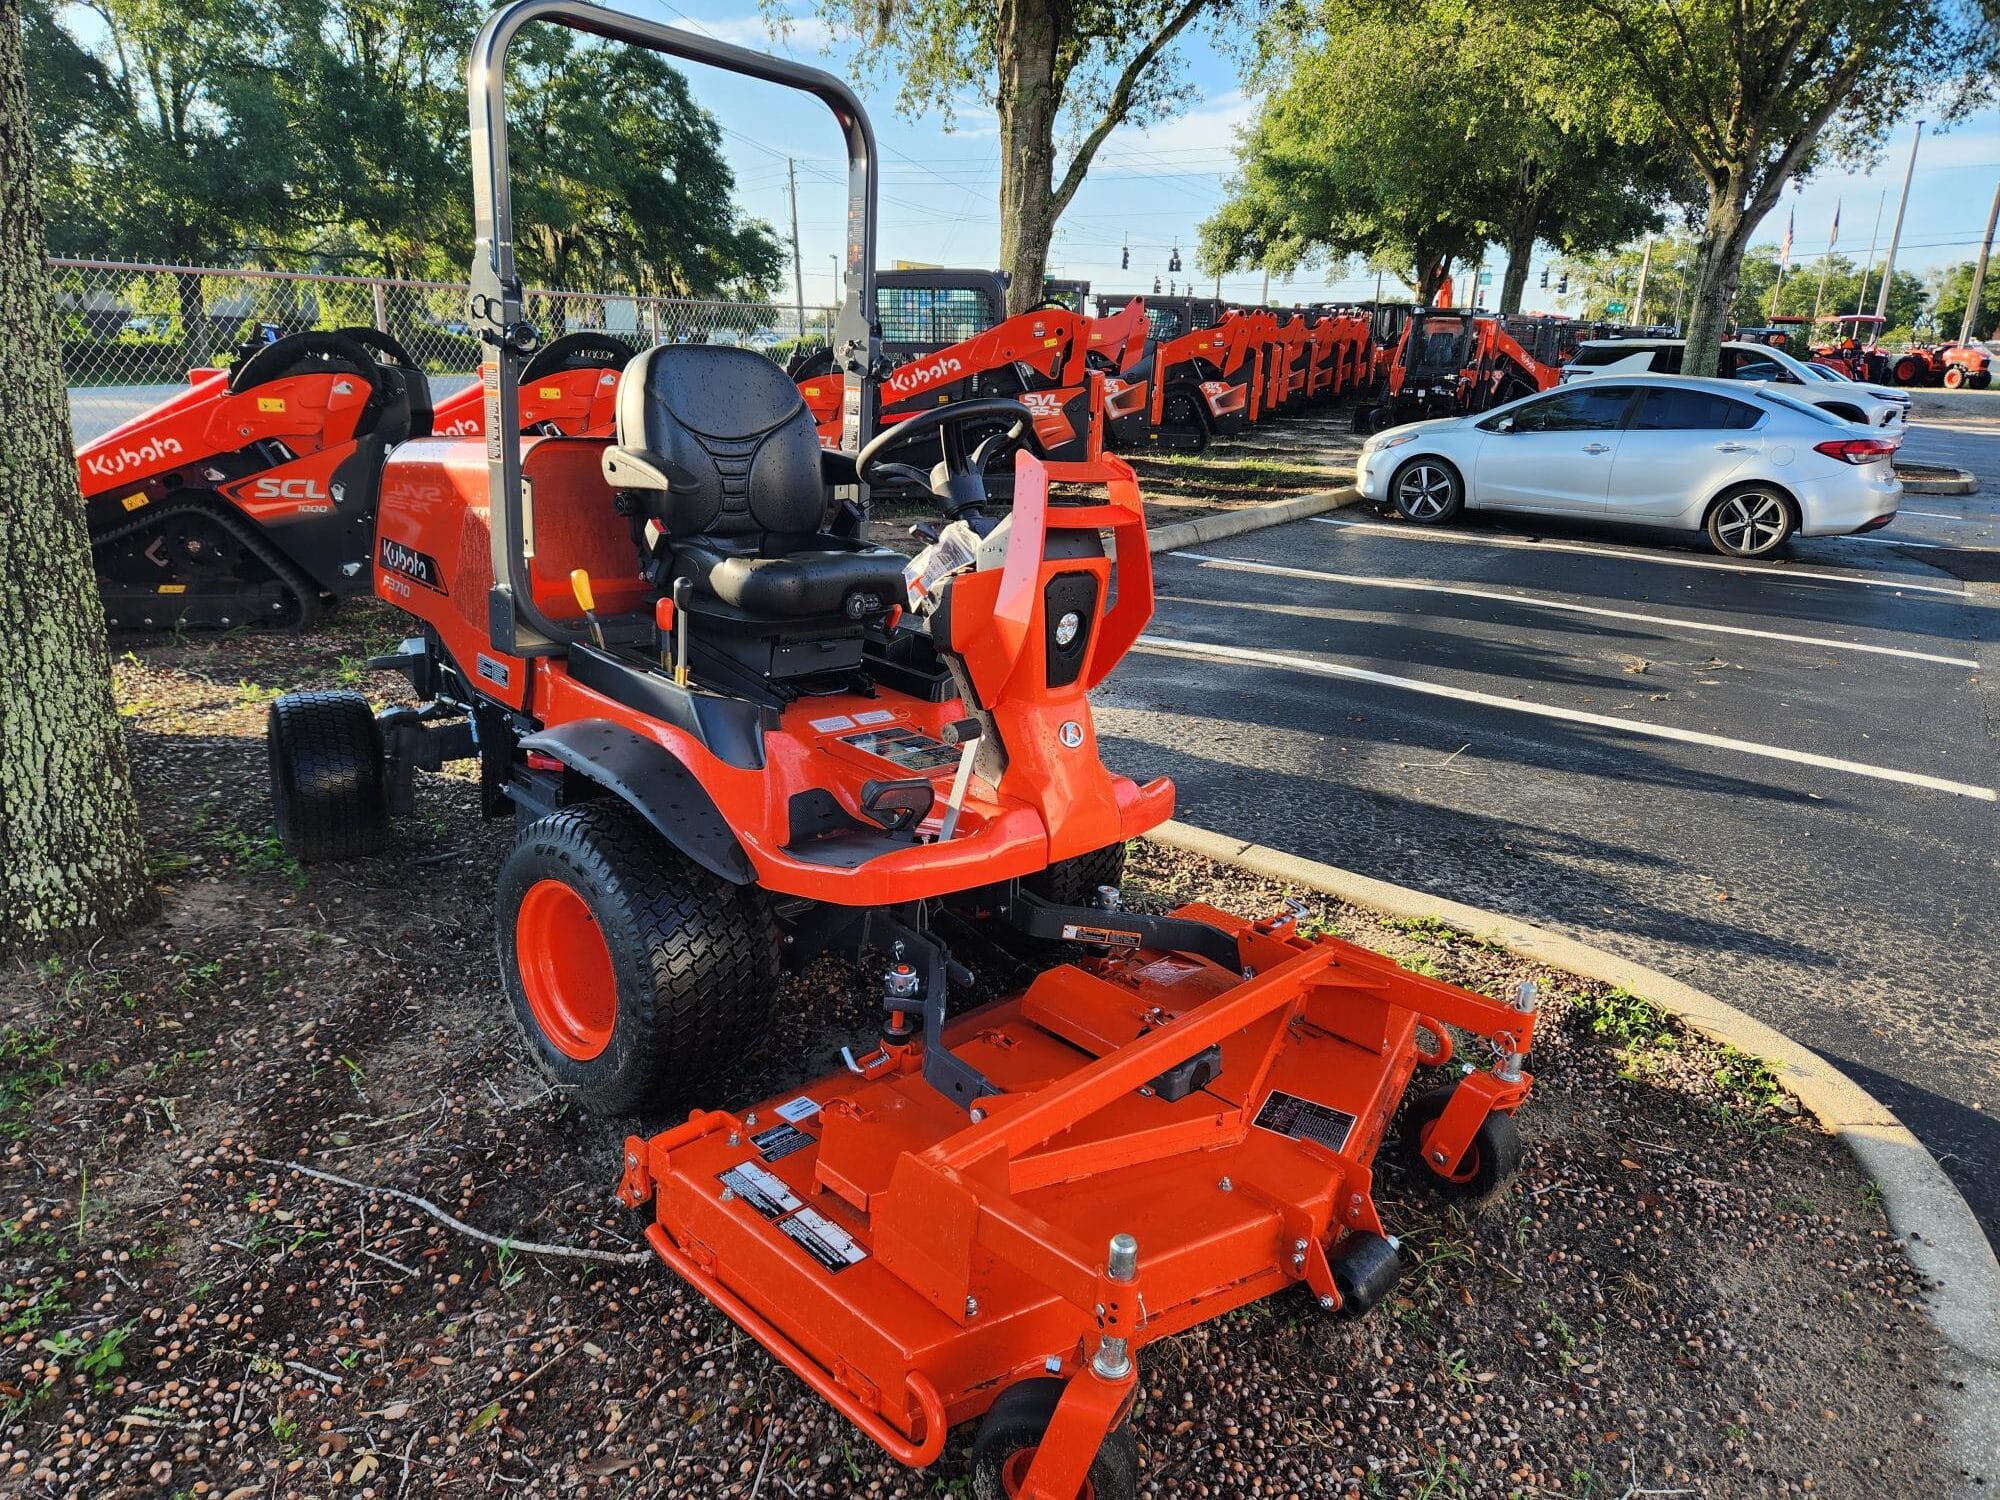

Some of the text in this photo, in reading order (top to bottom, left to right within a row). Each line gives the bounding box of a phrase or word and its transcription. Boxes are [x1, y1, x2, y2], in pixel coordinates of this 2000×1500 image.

[890, 357, 962, 392] Kubota
[1024, 393, 1062, 406] SVL
[86, 436, 184, 476] Kubota
[255, 479, 326, 499] SCL
[297, 505, 328, 513] 1000
[382, 539, 427, 580] Kubota
[382, 575, 411, 598] F3710
